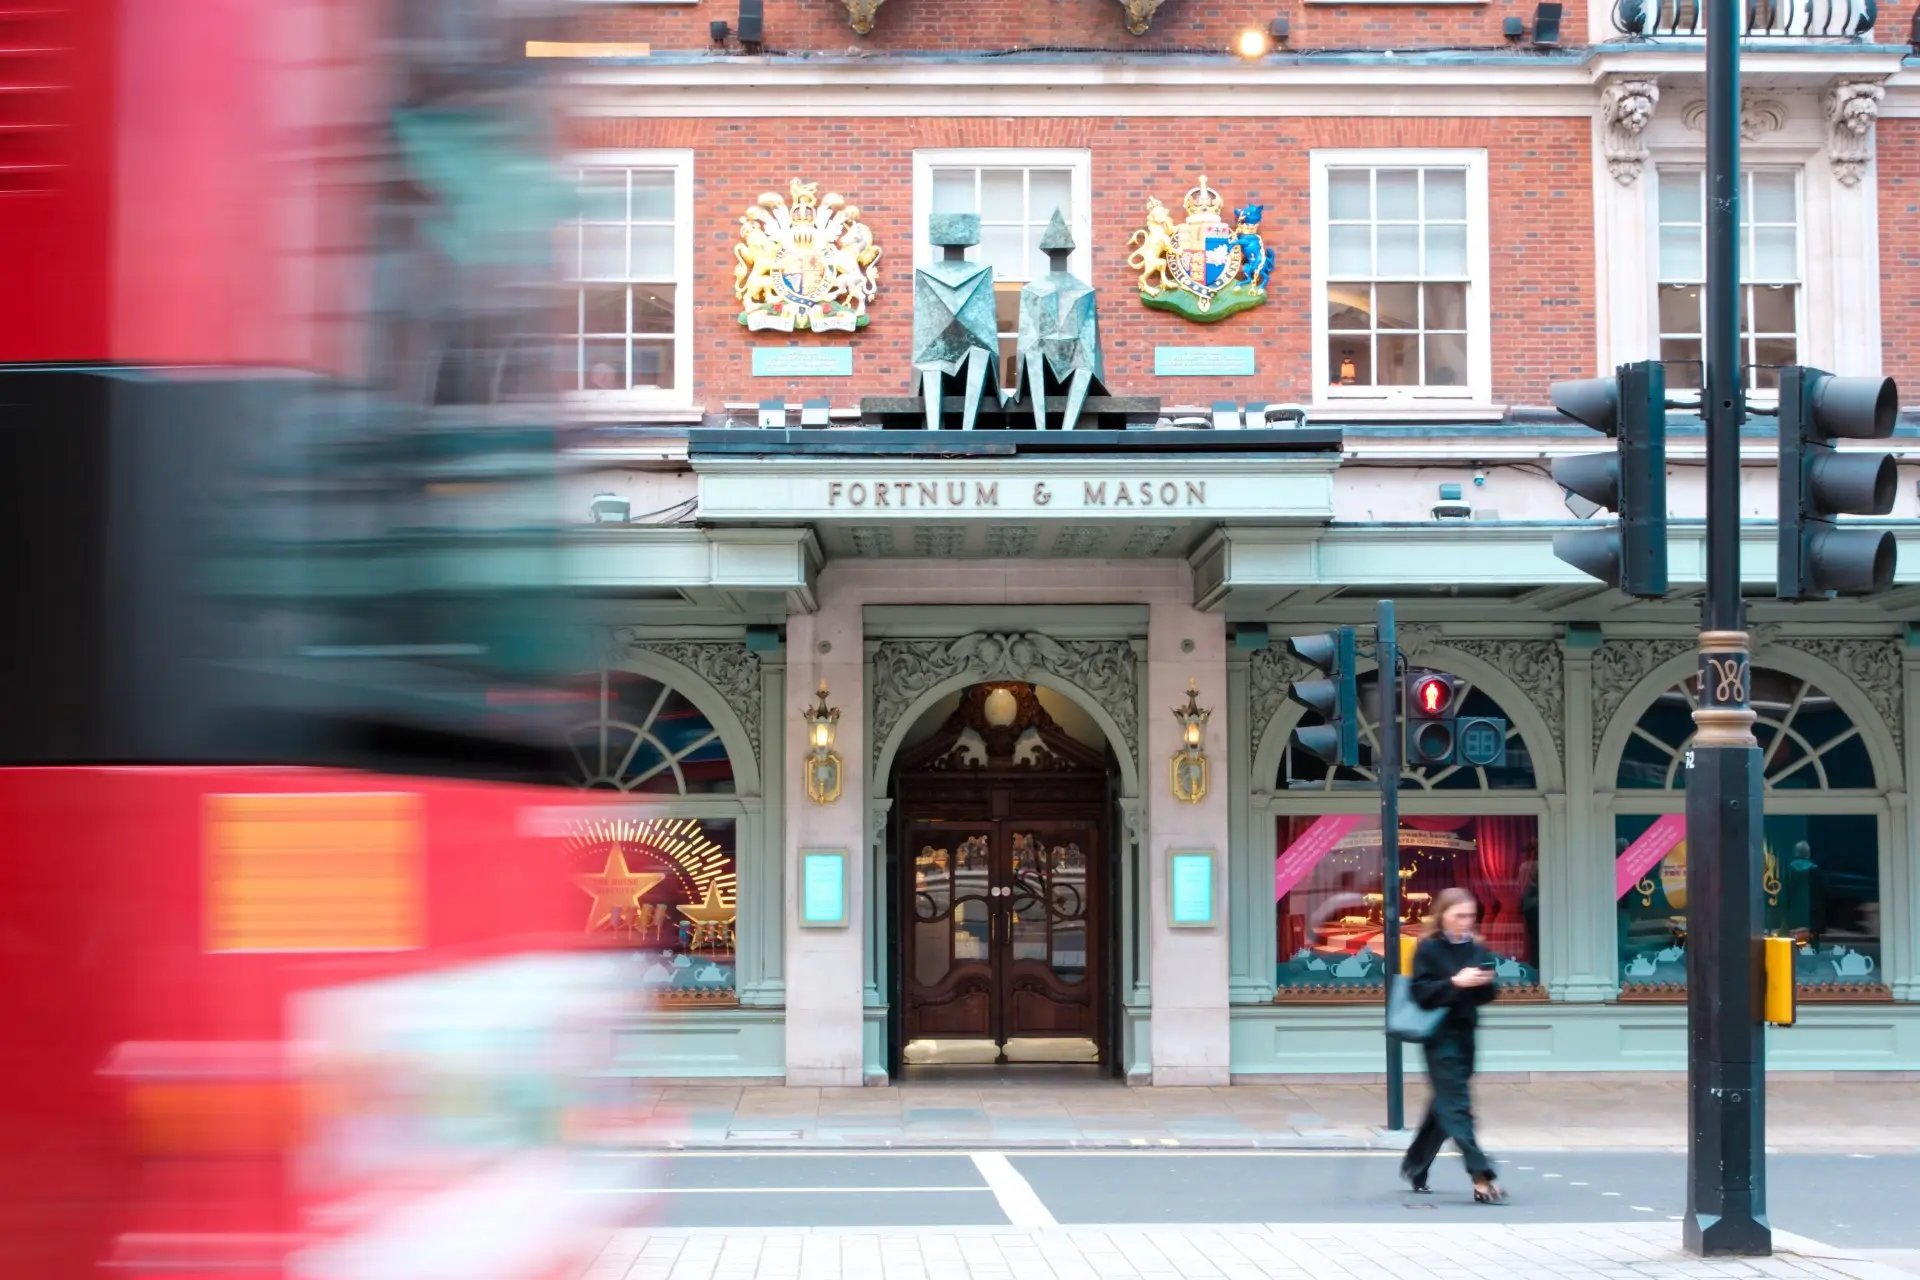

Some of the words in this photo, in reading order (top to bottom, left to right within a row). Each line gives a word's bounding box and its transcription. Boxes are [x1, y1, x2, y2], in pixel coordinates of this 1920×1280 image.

[828, 481, 999, 507] FORTNUM
[1033, 481, 1053, 506] &
[1083, 481, 1207, 507] MASON
